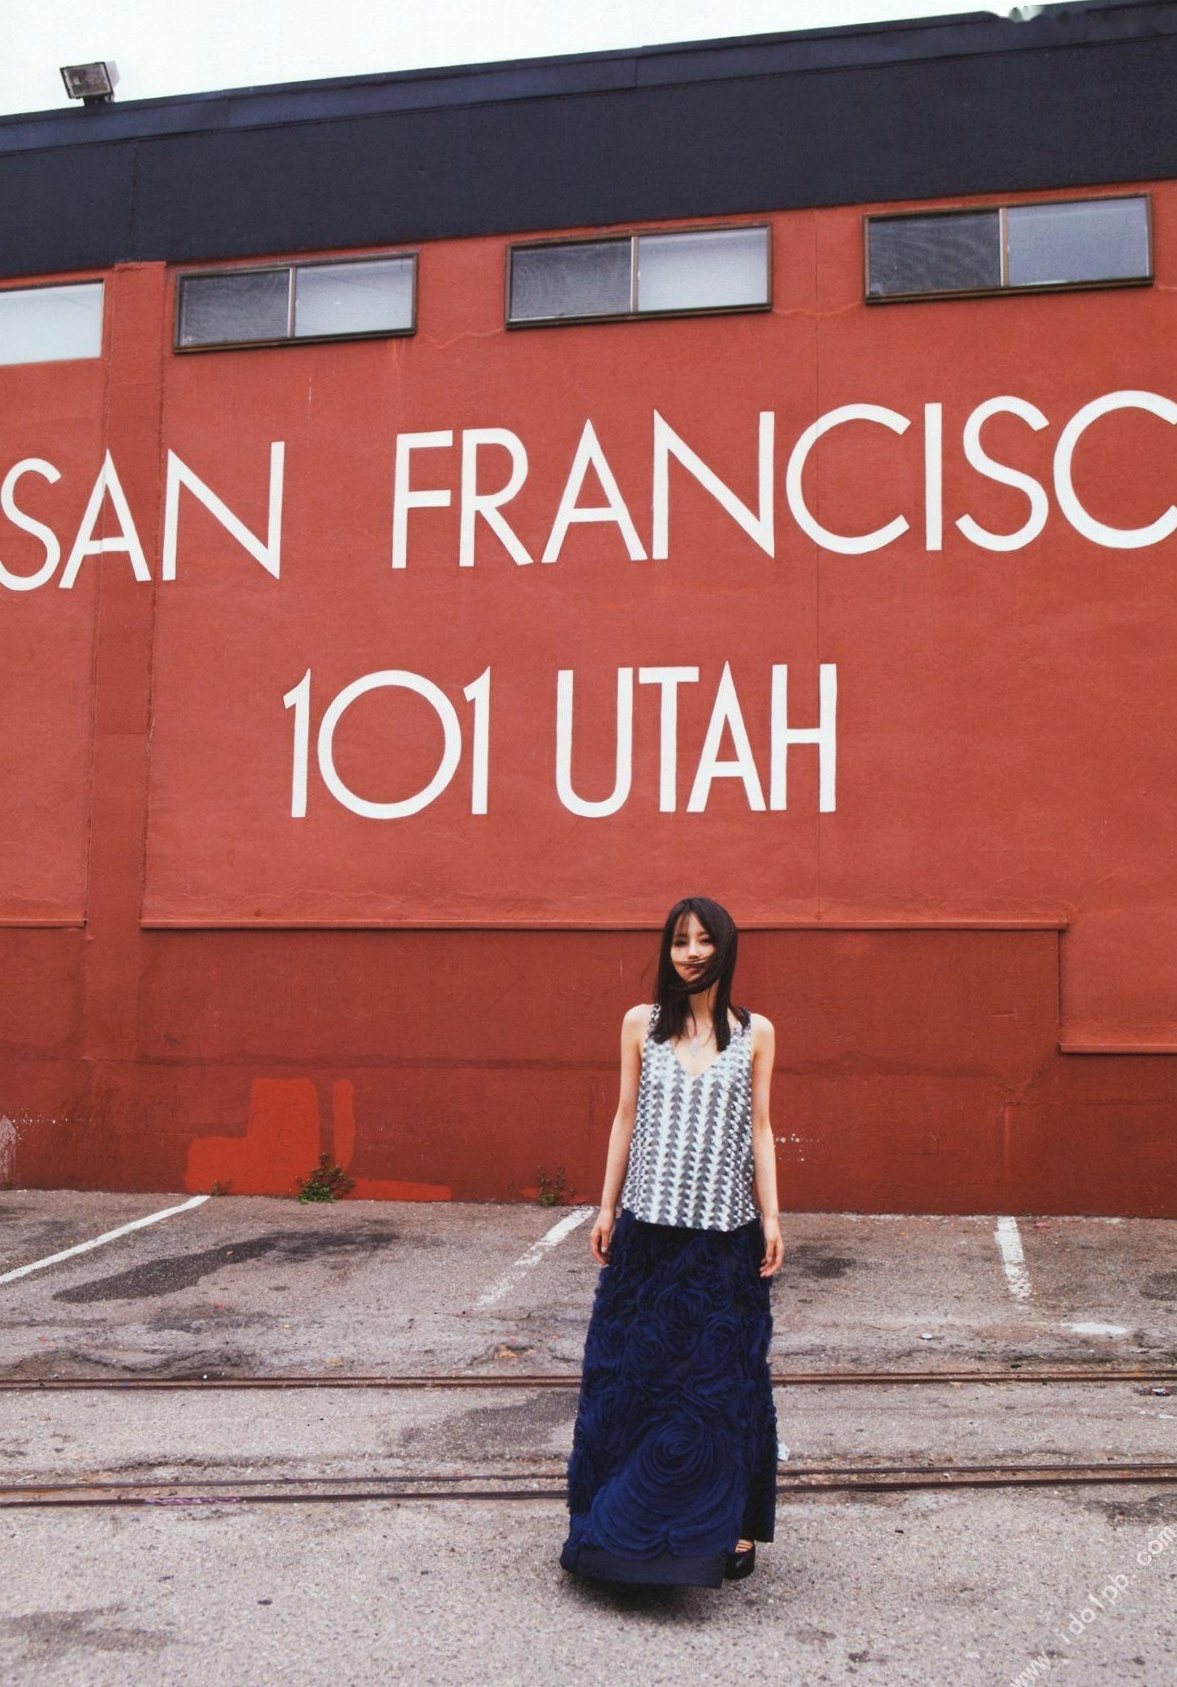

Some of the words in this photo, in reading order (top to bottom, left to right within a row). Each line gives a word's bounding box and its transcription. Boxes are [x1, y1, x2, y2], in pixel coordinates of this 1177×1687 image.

[0, 441, 286, 592] SAN
[282, 667, 491, 820] 101
[555, 660, 838, 819] UTAH
